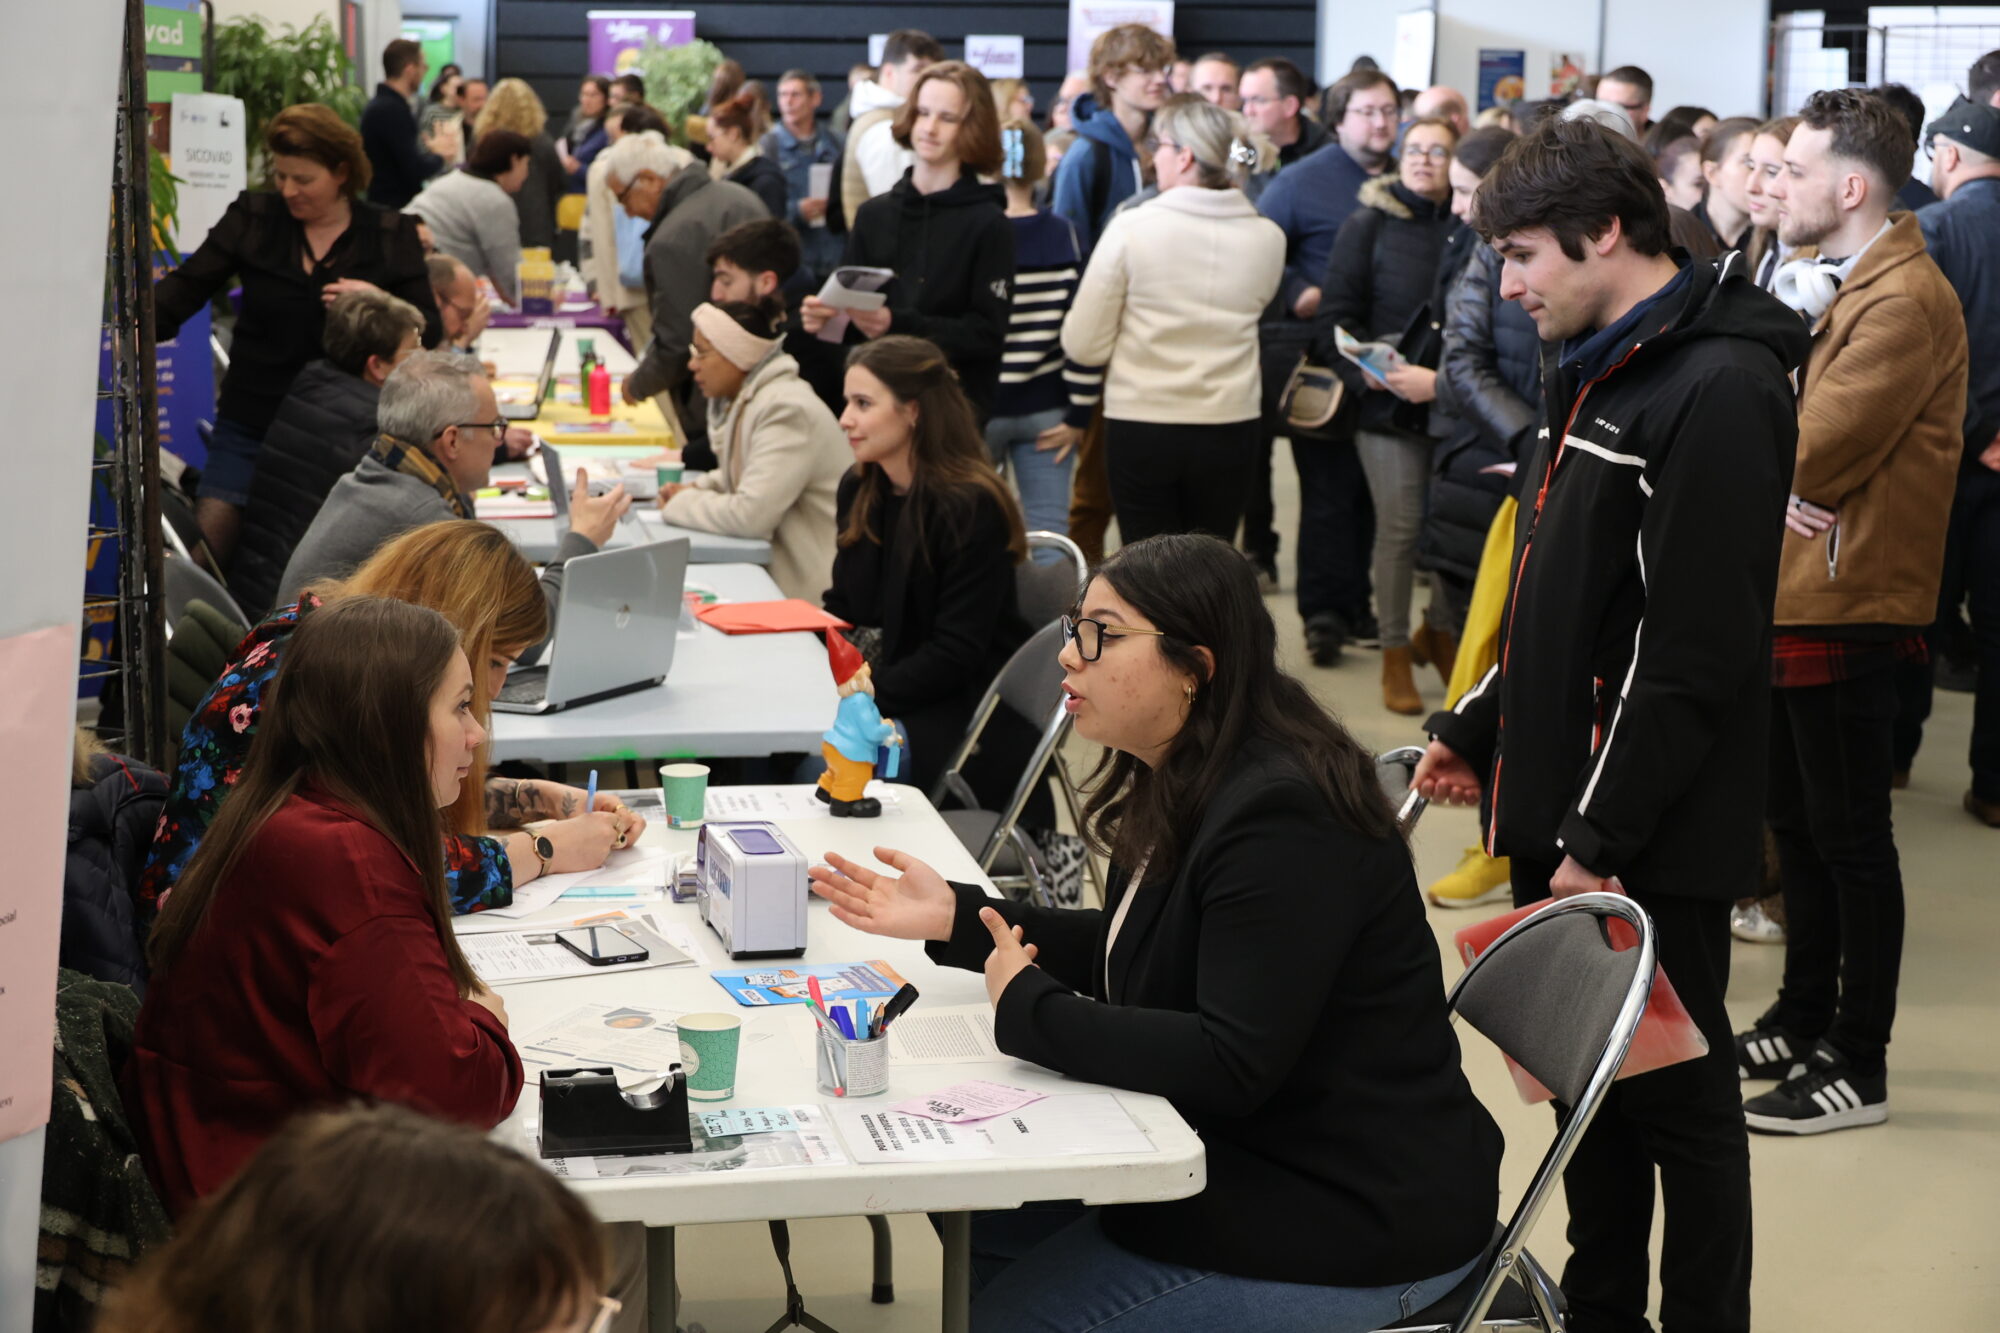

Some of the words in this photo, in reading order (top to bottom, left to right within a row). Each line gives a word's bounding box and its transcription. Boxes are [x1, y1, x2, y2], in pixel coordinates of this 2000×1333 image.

[144, 19, 184, 46] vad
[185, 147, 233, 166] SICOVAD
[0, 909, 17, 927] ocial
